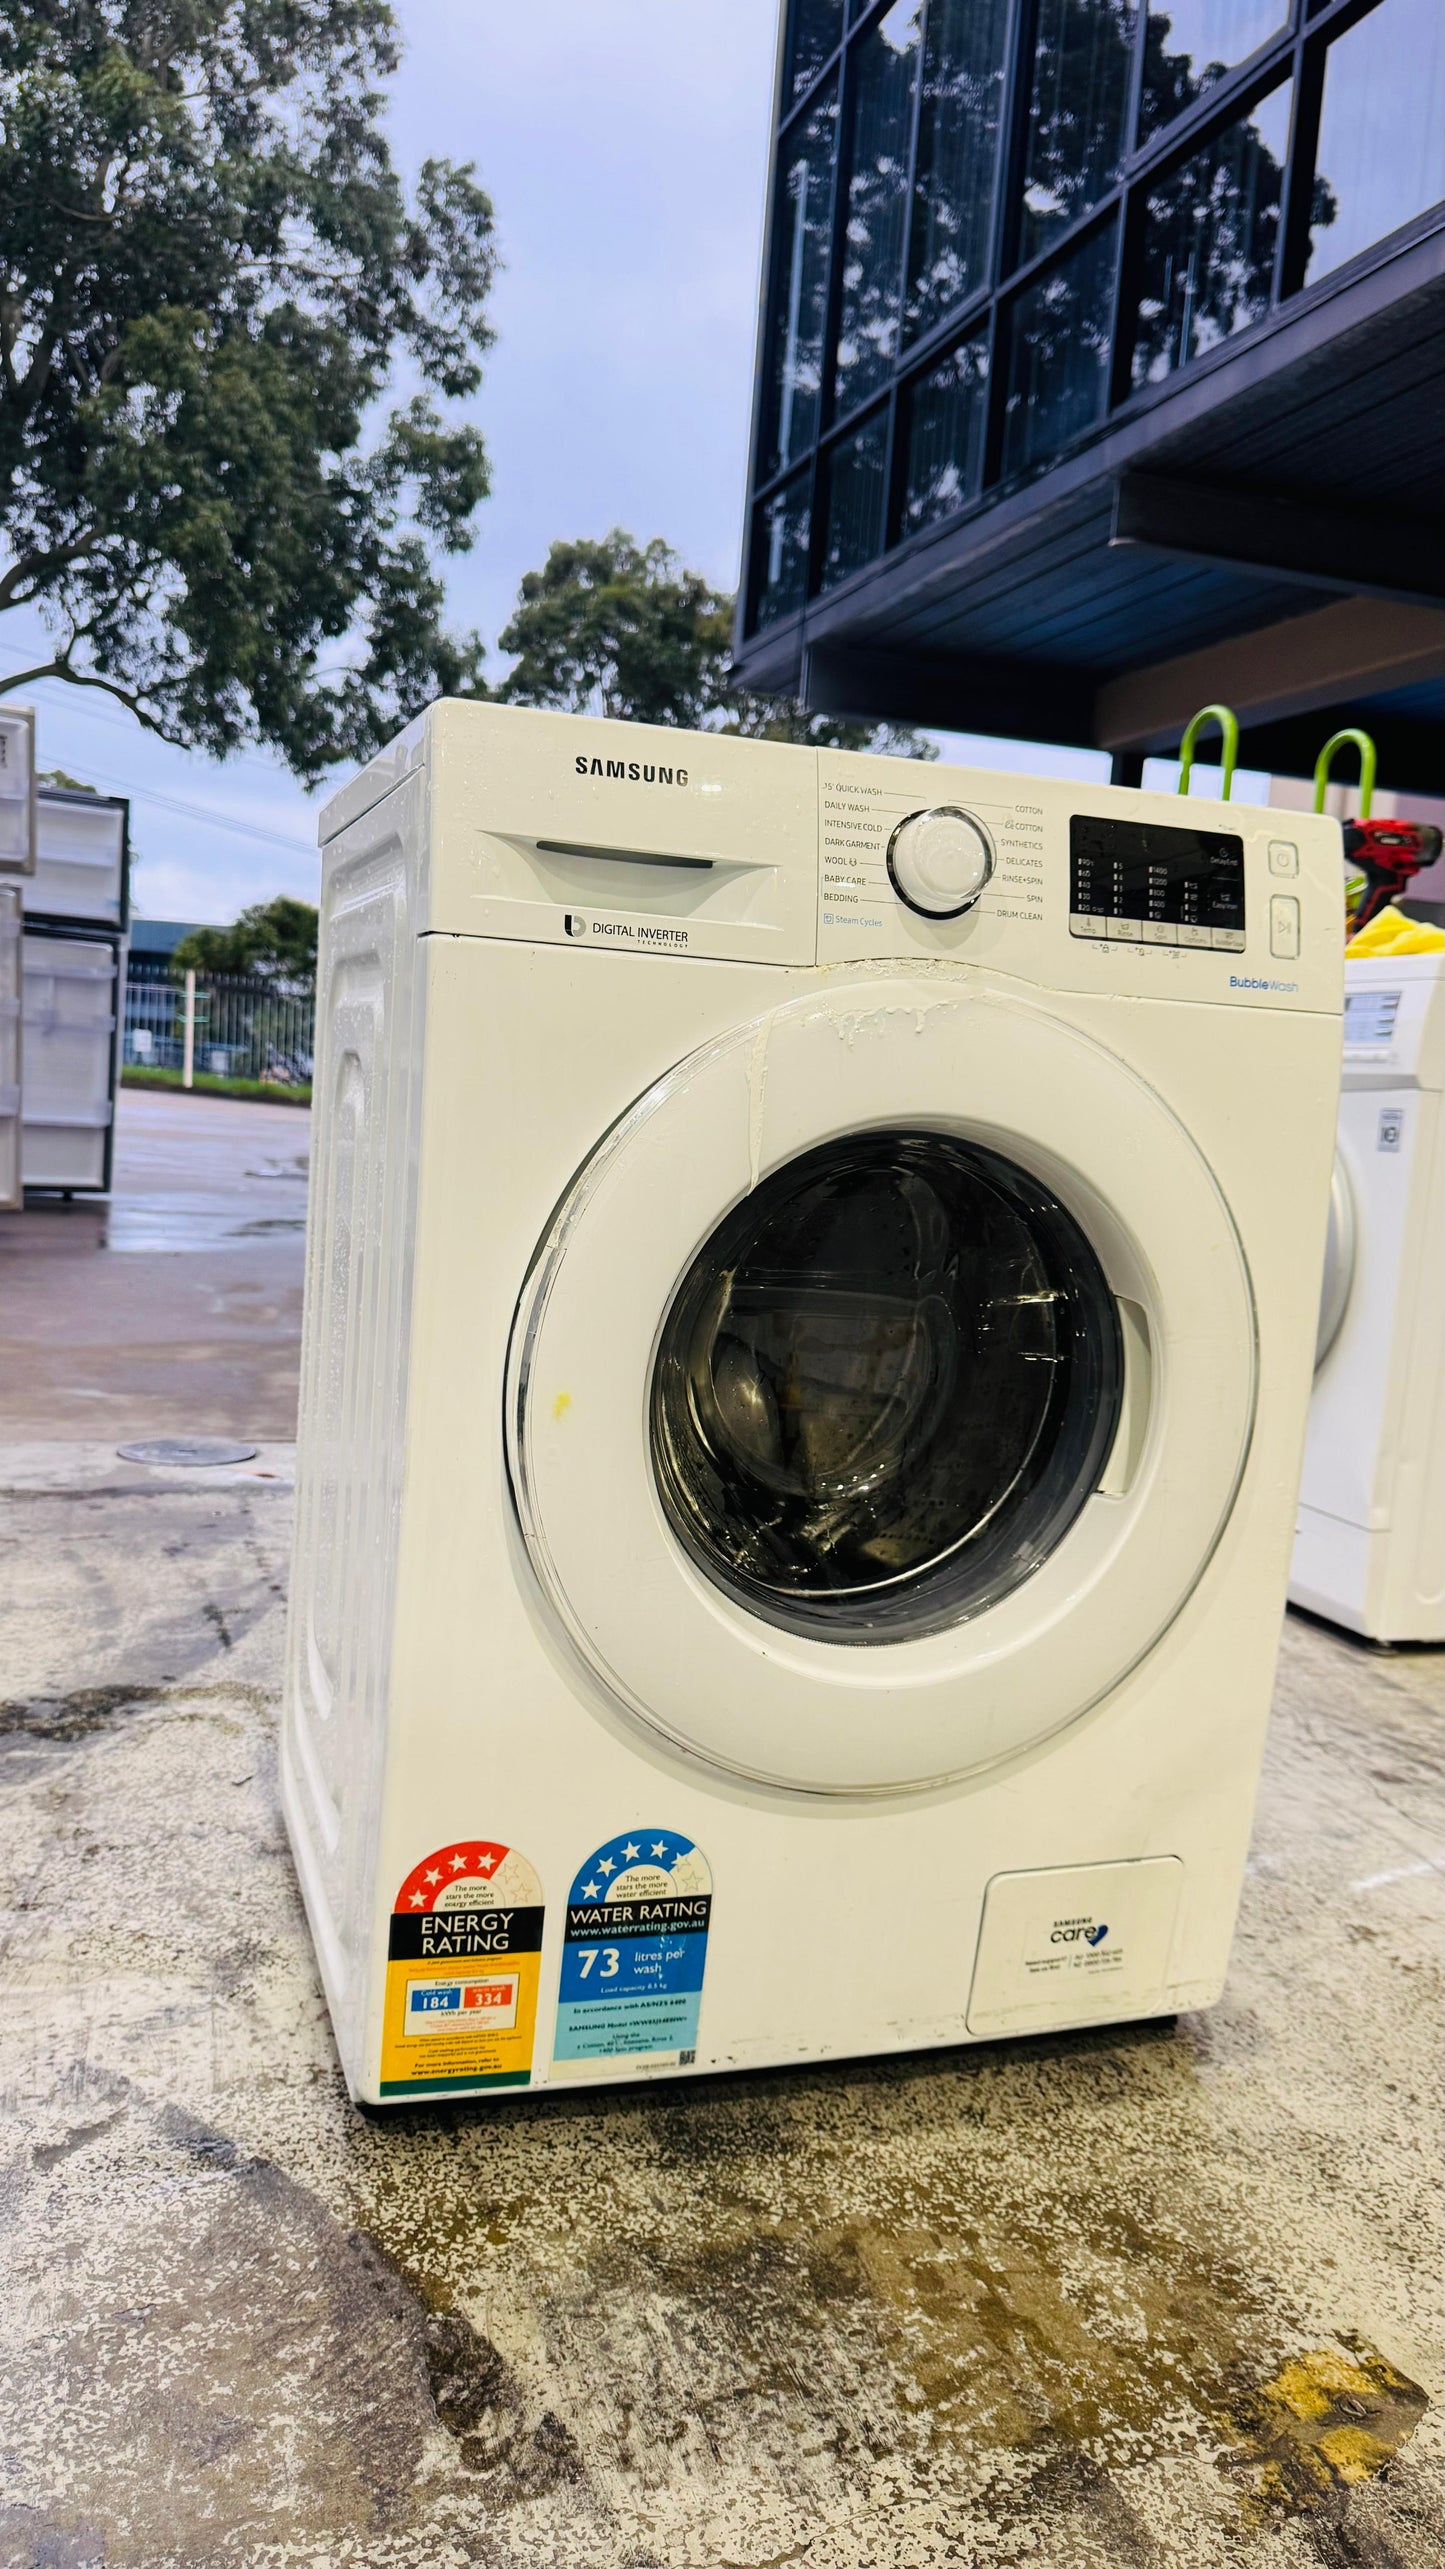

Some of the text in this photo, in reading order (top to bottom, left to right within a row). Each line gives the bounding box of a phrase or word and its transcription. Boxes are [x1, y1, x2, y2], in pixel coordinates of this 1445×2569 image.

[575, 756, 688, 786] SAMSUNG
[836, 783, 859, 793] QUICK
[860, 787, 882, 795] WASH
[825, 800, 870, 812] DAILY WASH
[1015, 805, 1043, 815] COTTON
[825, 819, 883, 832] INTENSIVE COLD
[1015, 822, 1043, 832] COTTON
[825, 837, 881, 850] DARK GARMENT
[1000, 838, 1043, 850] SYNTHETICS
[824, 856, 847, 865] WOOL
[1006, 857, 1043, 868] DELICATES
[824, 874, 866, 885] BABY CARE
[1081, 881, 1091, 889] 40
[824, 893, 858, 903] BEDDING
[1026, 894, 1043, 903] SPIN
[836, 915, 883, 927] Steam Cycles
[997, 909, 1043, 921] DRUM CLEAN
[593, 923, 688, 942] DIGITAL INVERTER
[637, 939, 688, 948] TECHNOLOGY
[639, 1889, 666, 1897] efficient
[570, 1901, 707, 1924] WATER RATING
[421, 1912, 514, 1935] ENERGY
[570, 1919, 705, 1937] www.waterrating.gov.au
[1053, 1917, 1092, 1927] SAMSUNG
[1050, 1926, 1097, 1943] care
[421, 1933, 509, 1955] RATING
[578, 1948, 685, 1979] 73 litres per
[633, 1963, 662, 1974] wash
[422, 1996, 449, 2009] 184
[475, 1993, 502, 2005] 334
[582, 2005, 622, 2013] accordance
